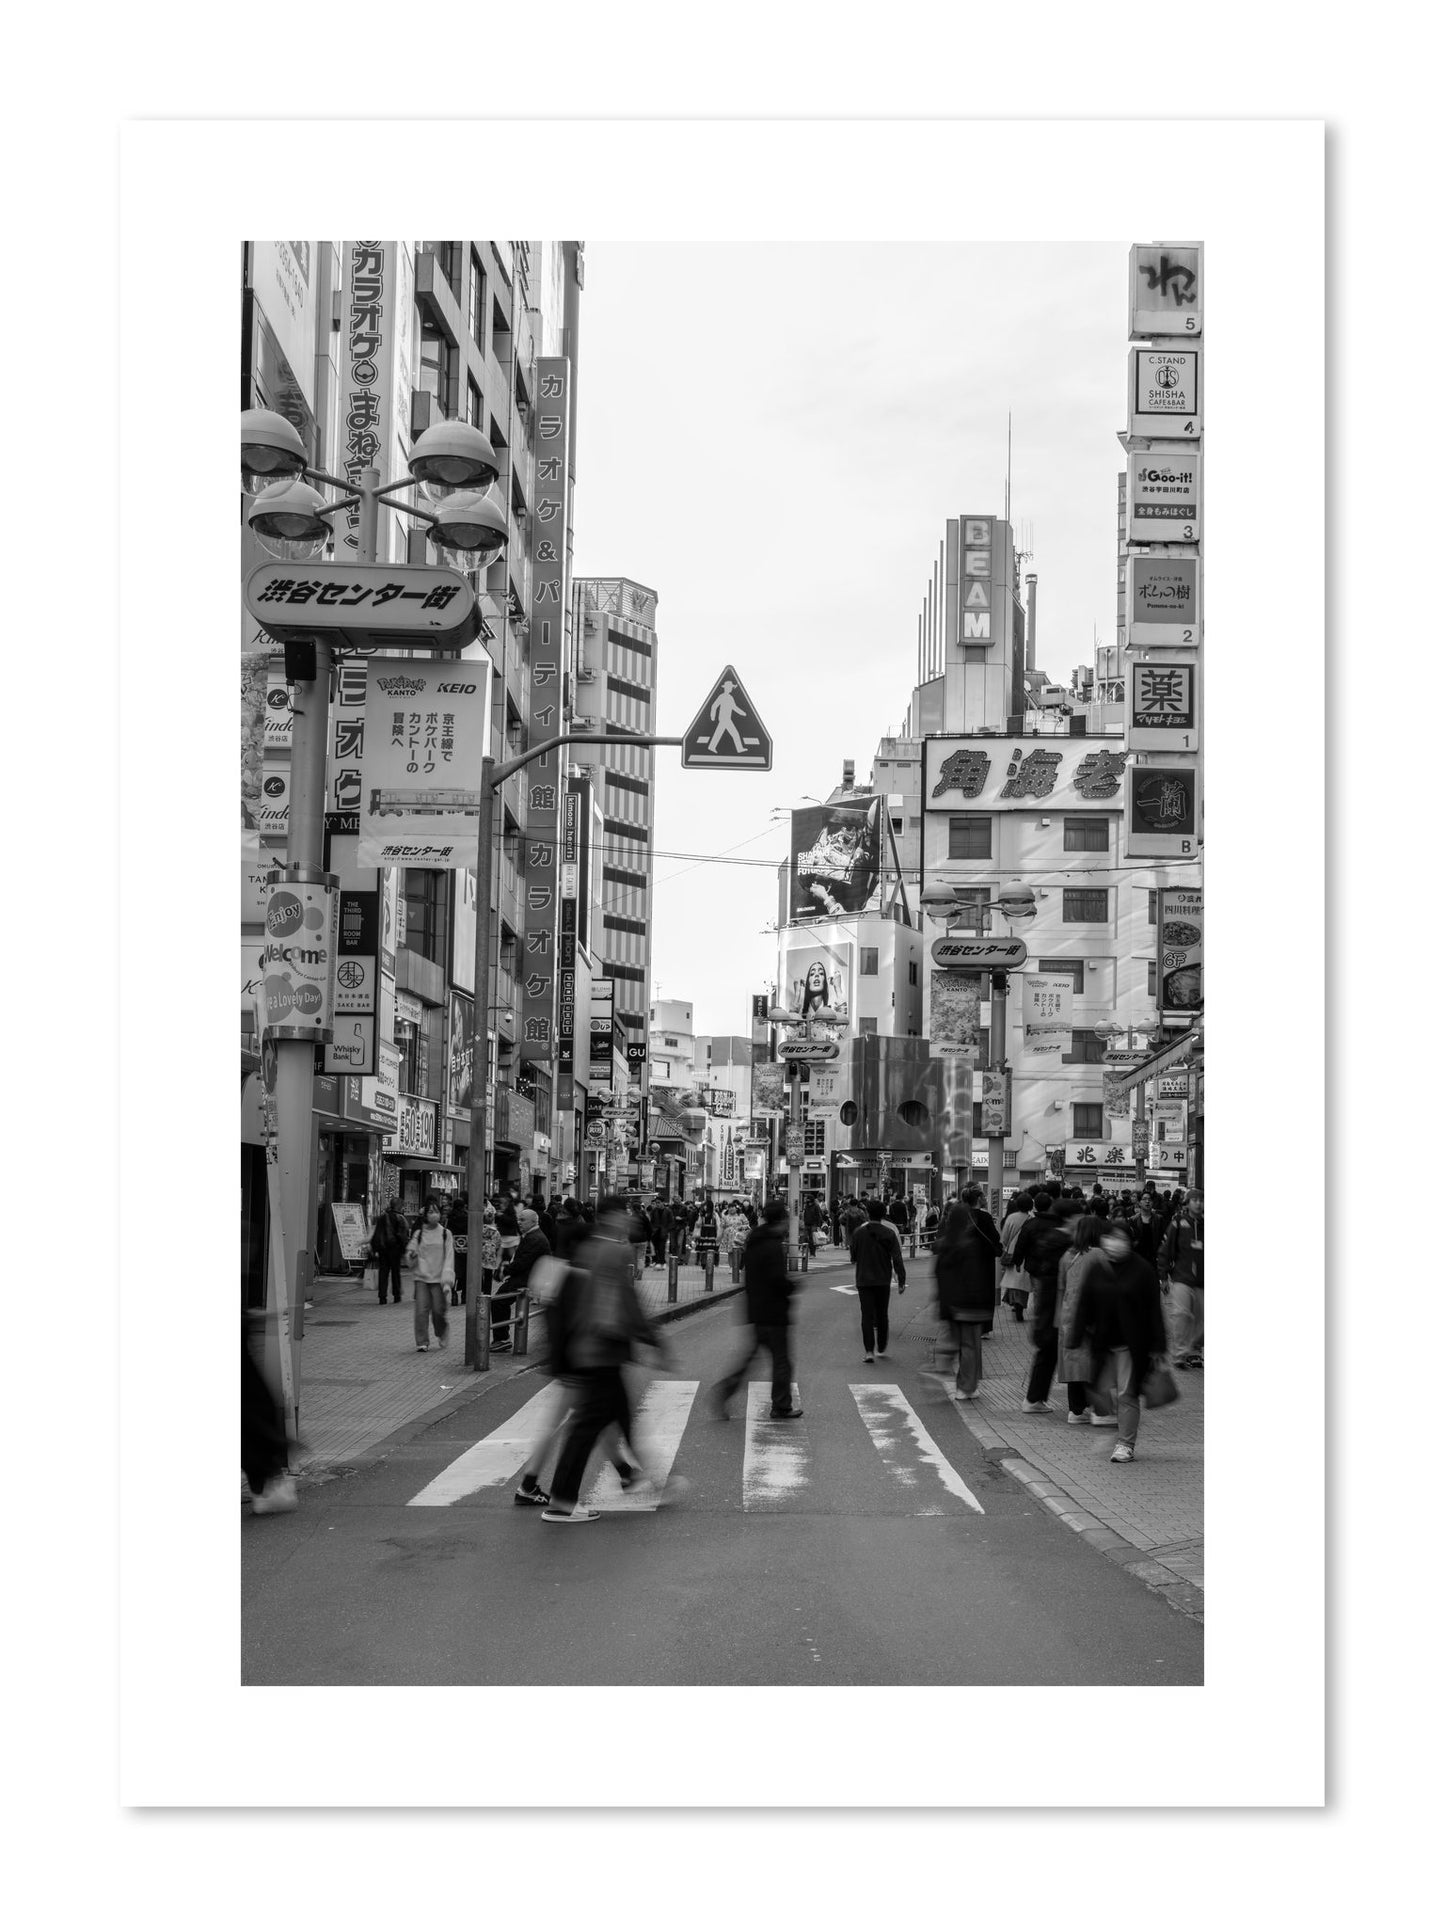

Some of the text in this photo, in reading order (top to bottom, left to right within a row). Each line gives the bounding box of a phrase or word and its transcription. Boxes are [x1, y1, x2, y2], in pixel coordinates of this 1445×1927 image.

[350, 248, 384, 361] カラオケ
[1185, 318, 1195, 330] 5
[1148, 390, 1185, 399] SHISHA
[1138, 506, 1193, 517] 全身もみほぐし
[1184, 526, 1193, 538] 3
[964, 520, 991, 638] BEAM
[257, 578, 461, 610] 渋谷センター街
[1183, 630, 1193, 642] 2
[437, 683, 477, 695] KEIO
[1141, 670, 1183, 711] 薬
[391, 712, 405, 747] 冒険へ
[441, 713, 455, 762] 京王線で
[406, 712, 421, 773] カントーの
[1183, 735, 1189, 747] 1
[932, 748, 1128, 799] 角海老
[567, 798, 575, 827] kimono
[1182, 841, 1191, 853] B
[267, 902, 301, 930] Enjoy
[524, 843, 554, 1042] カラオケ館
[1163, 952, 1187, 968] 6F
[278, 991, 303, 1008] Lovely
[304, 992, 321, 1005] Day!
[333, 1045, 361, 1055] Whisky
[629, 1048, 645, 1057] GU
